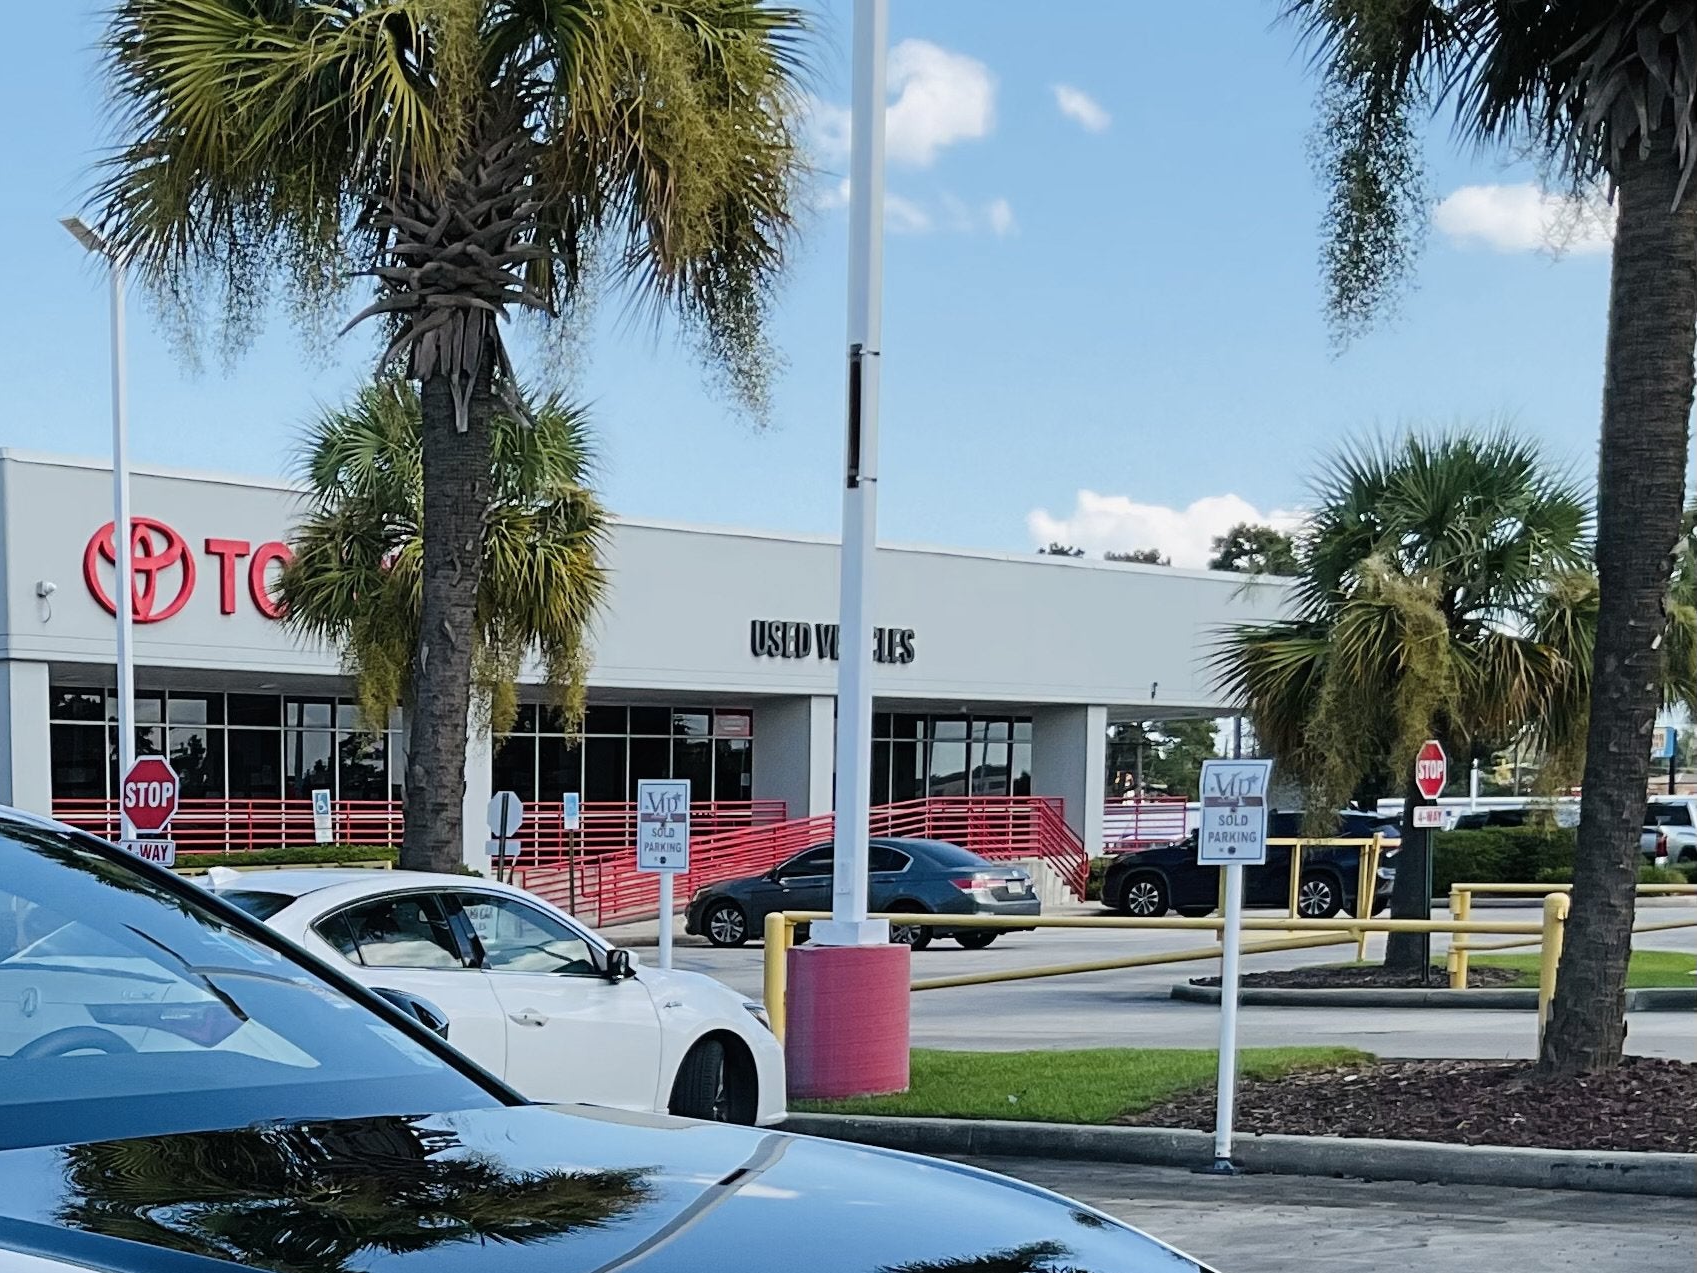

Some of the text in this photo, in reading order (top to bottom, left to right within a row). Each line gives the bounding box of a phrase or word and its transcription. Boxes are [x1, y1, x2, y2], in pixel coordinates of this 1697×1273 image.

[750, 619, 812, 659] USED
[1418, 760, 1444, 780] STOP
[124, 781, 174, 808] STOP
[1218, 815, 1248, 826] SOLD
[1417, 811, 1442, 822] 4-WAY
[651, 827, 675, 838] SOLD
[1208, 831, 1257, 843] PARKING
[644, 842, 682, 853] PARKING
